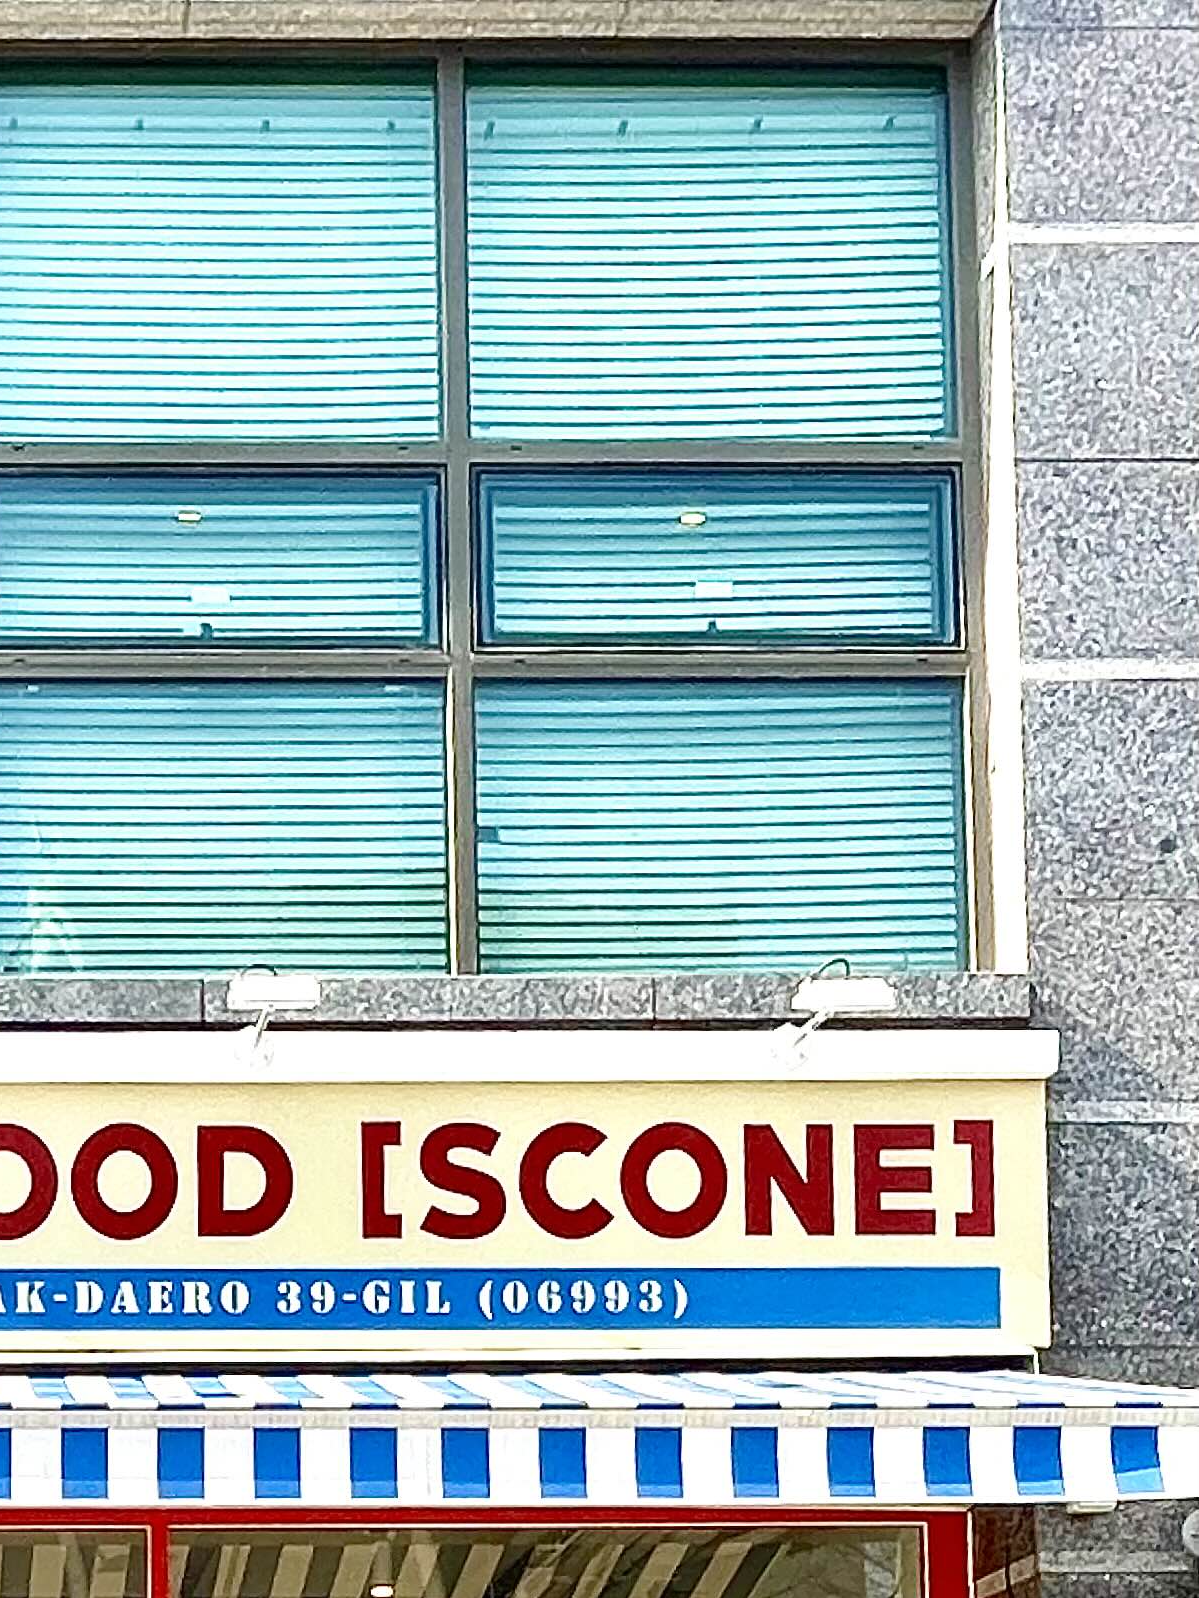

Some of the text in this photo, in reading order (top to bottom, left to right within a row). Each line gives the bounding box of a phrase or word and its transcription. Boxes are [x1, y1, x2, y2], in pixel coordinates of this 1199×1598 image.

[360, 1119, 996, 1240] [SCONE]
[276, 1279, 451, 1315] 39-GIL
[478, 1278, 689, 1321] (06993)
